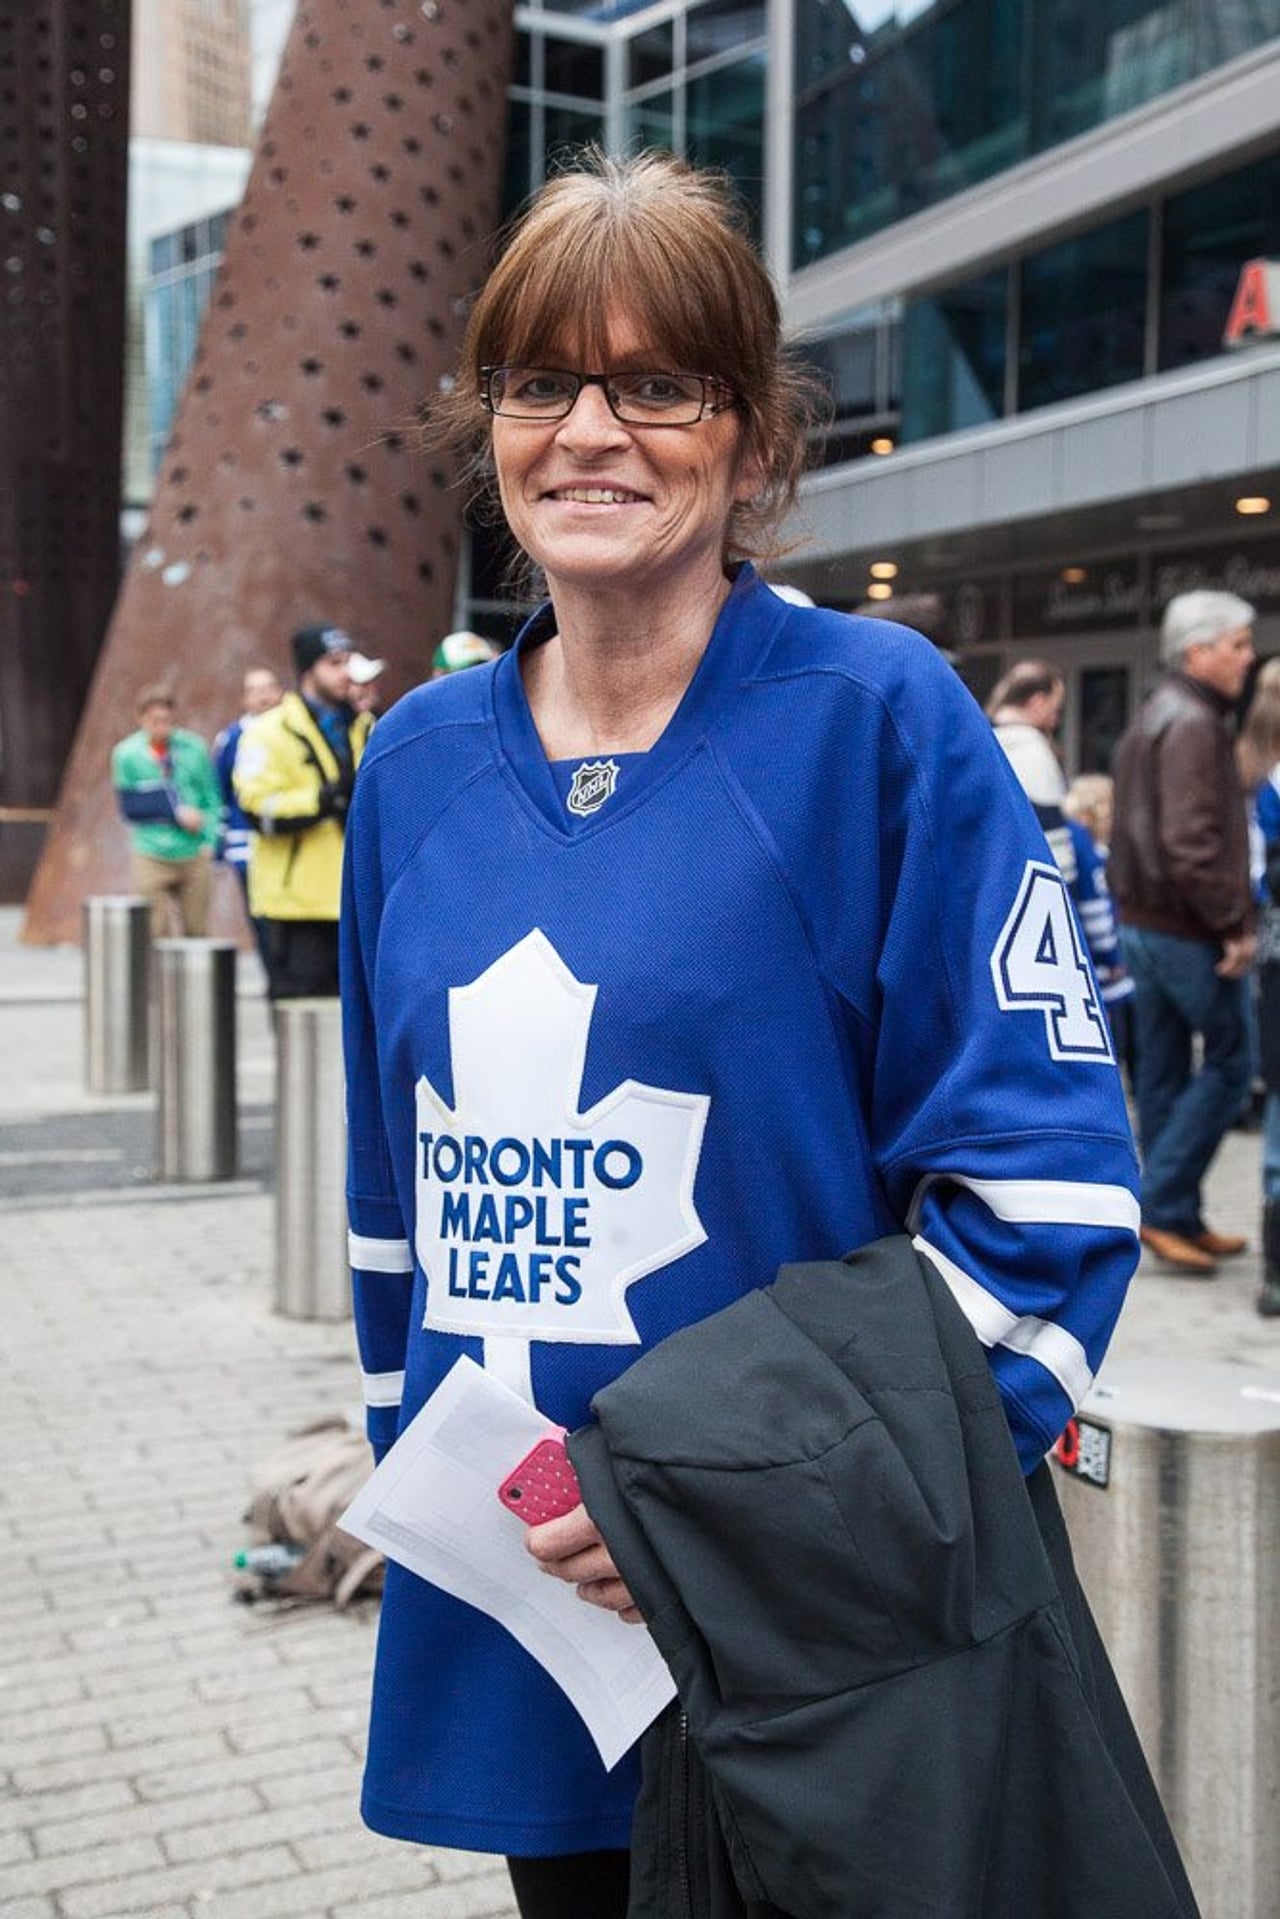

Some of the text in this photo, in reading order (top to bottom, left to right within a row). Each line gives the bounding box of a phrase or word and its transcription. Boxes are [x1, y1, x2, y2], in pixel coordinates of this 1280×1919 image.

[990, 860, 1116, 1065] 4
[419, 1132, 643, 1190] TORONTO
[440, 1191, 591, 1248] MAPLE
[448, 1248, 582, 1305] LEAFS
